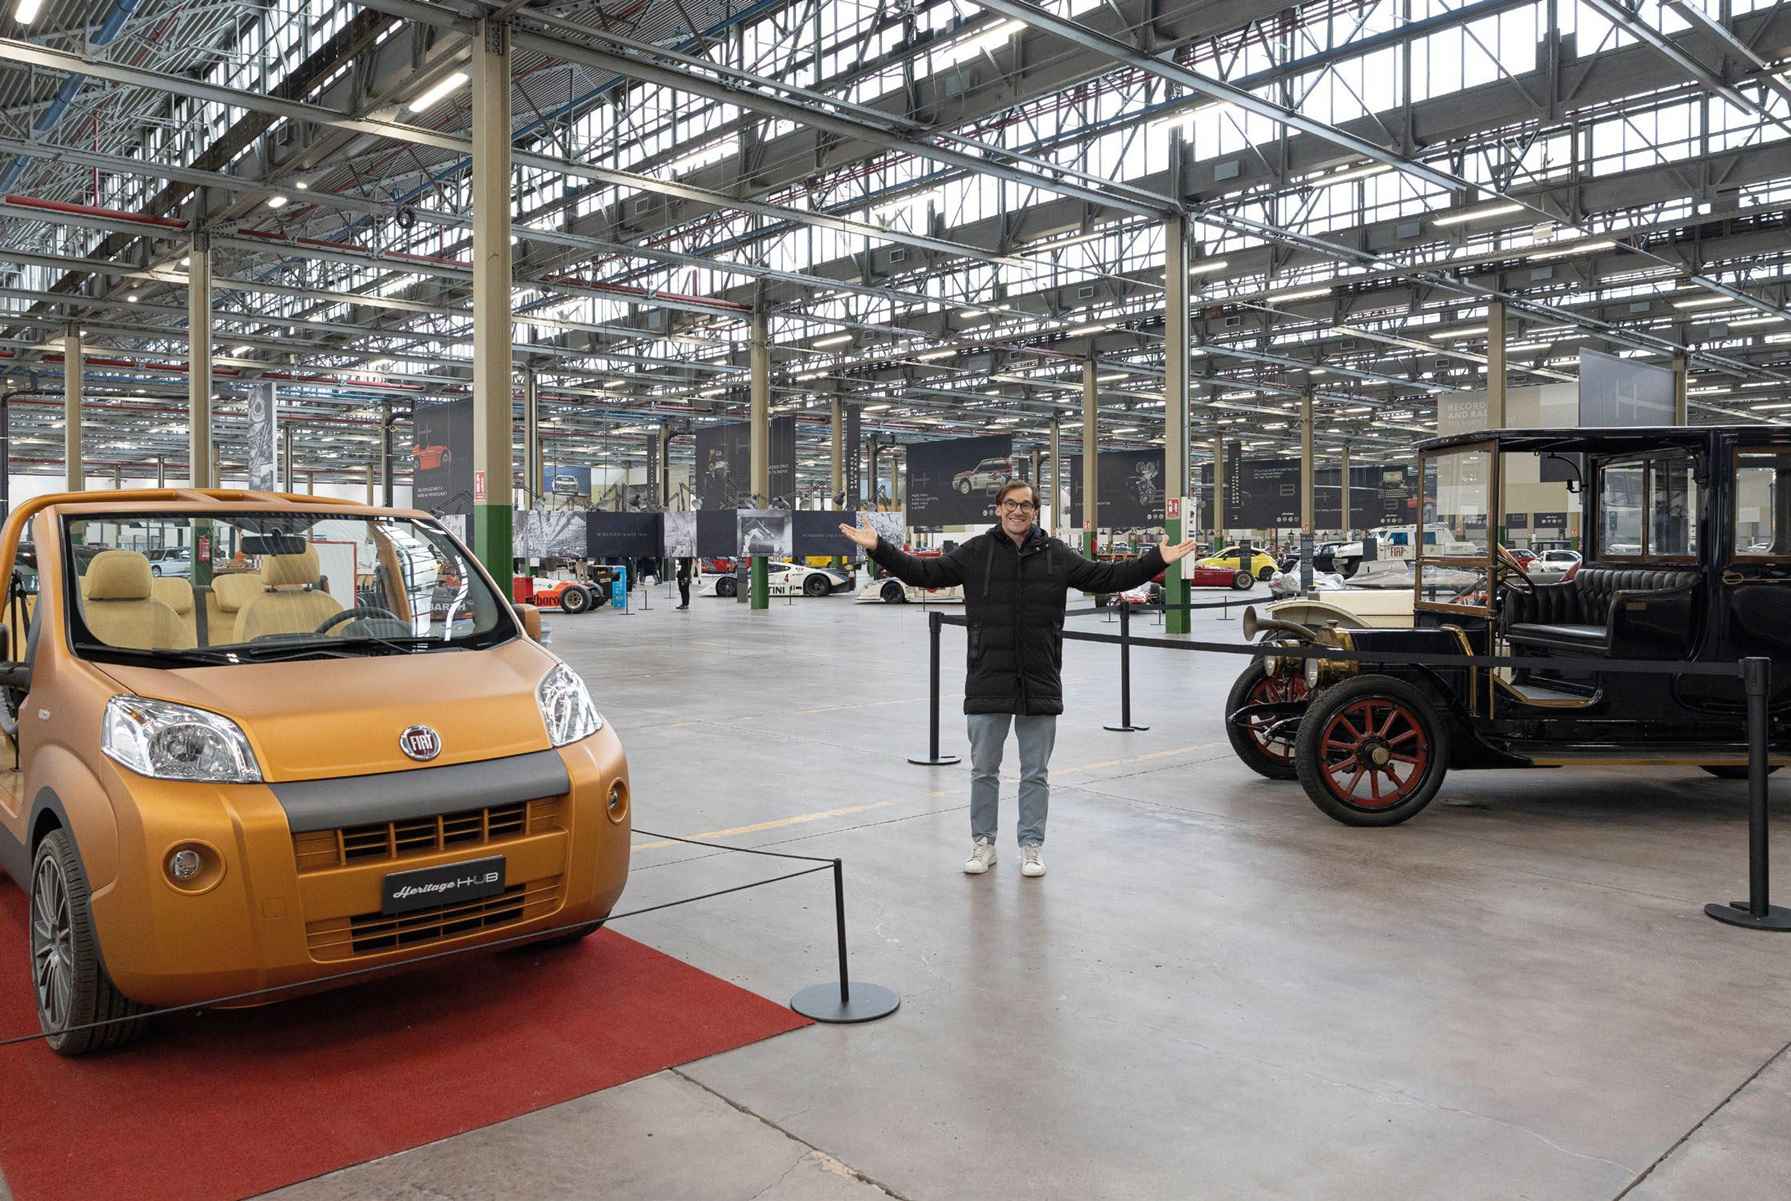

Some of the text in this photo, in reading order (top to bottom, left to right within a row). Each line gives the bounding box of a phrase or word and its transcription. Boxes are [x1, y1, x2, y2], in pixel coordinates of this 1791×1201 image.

[410, 734, 433, 751] FIAT
[392, 871, 499, 899] Heritage HUB
